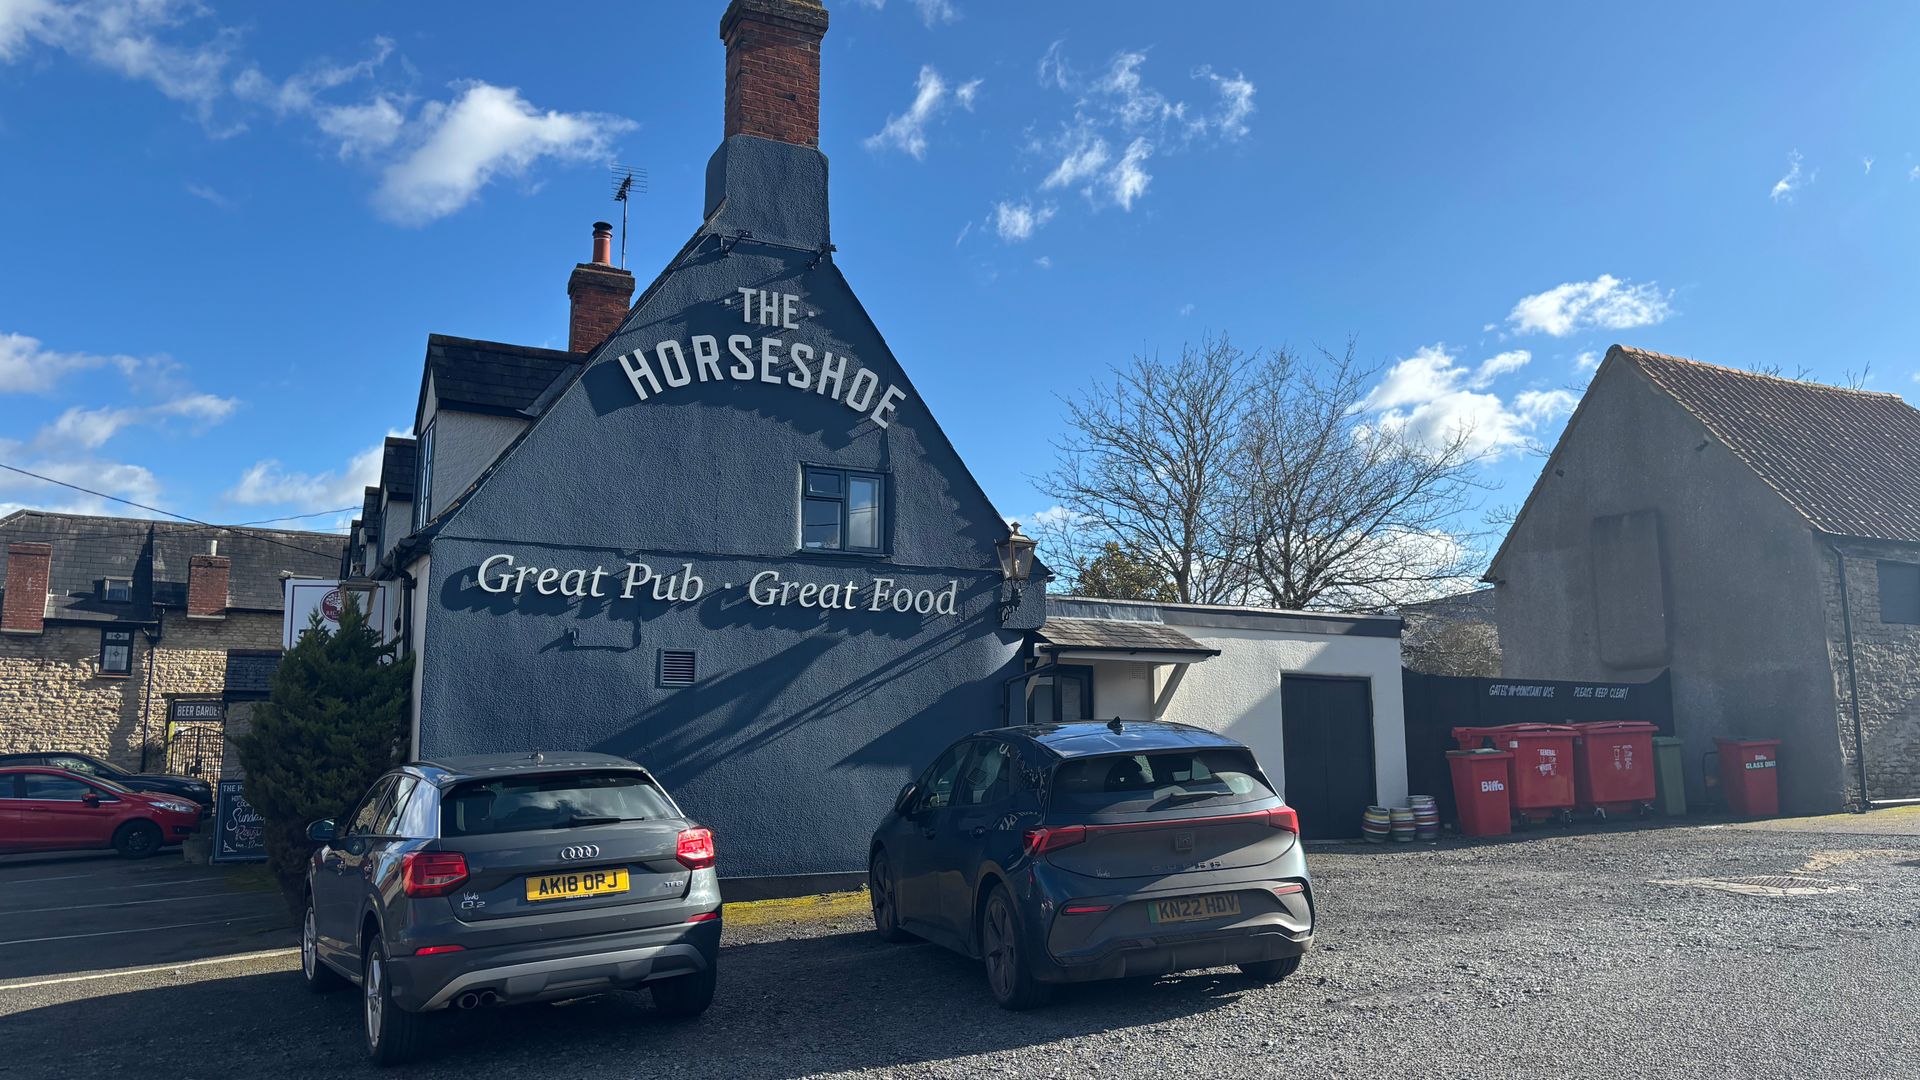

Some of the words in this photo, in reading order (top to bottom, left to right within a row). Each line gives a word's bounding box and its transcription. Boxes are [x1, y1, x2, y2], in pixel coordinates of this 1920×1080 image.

[738, 287, 800, 330] THE
[618, 334, 907, 429] HORSESHOE
[477, 553, 609, 598] Great
[620, 562, 704, 602] Pub
[749, 570, 859, 610] Great
[868, 577, 959, 615] Food
[1489, 684, 1508, 696] GATES
[1543, 686, 1555, 698] USE
[1573, 686, 1593, 698] PLEASE
[1595, 687, 1608, 698] KEEP
[177, 705, 194, 717] BEER
[1481, 780, 1504, 792] Biffa
[538, 875, 578, 896] AK18
[583, 871, 618, 891] OPJ
[1158, 900, 1202, 919] KN22
[1205, 895, 1236, 914] HDV
